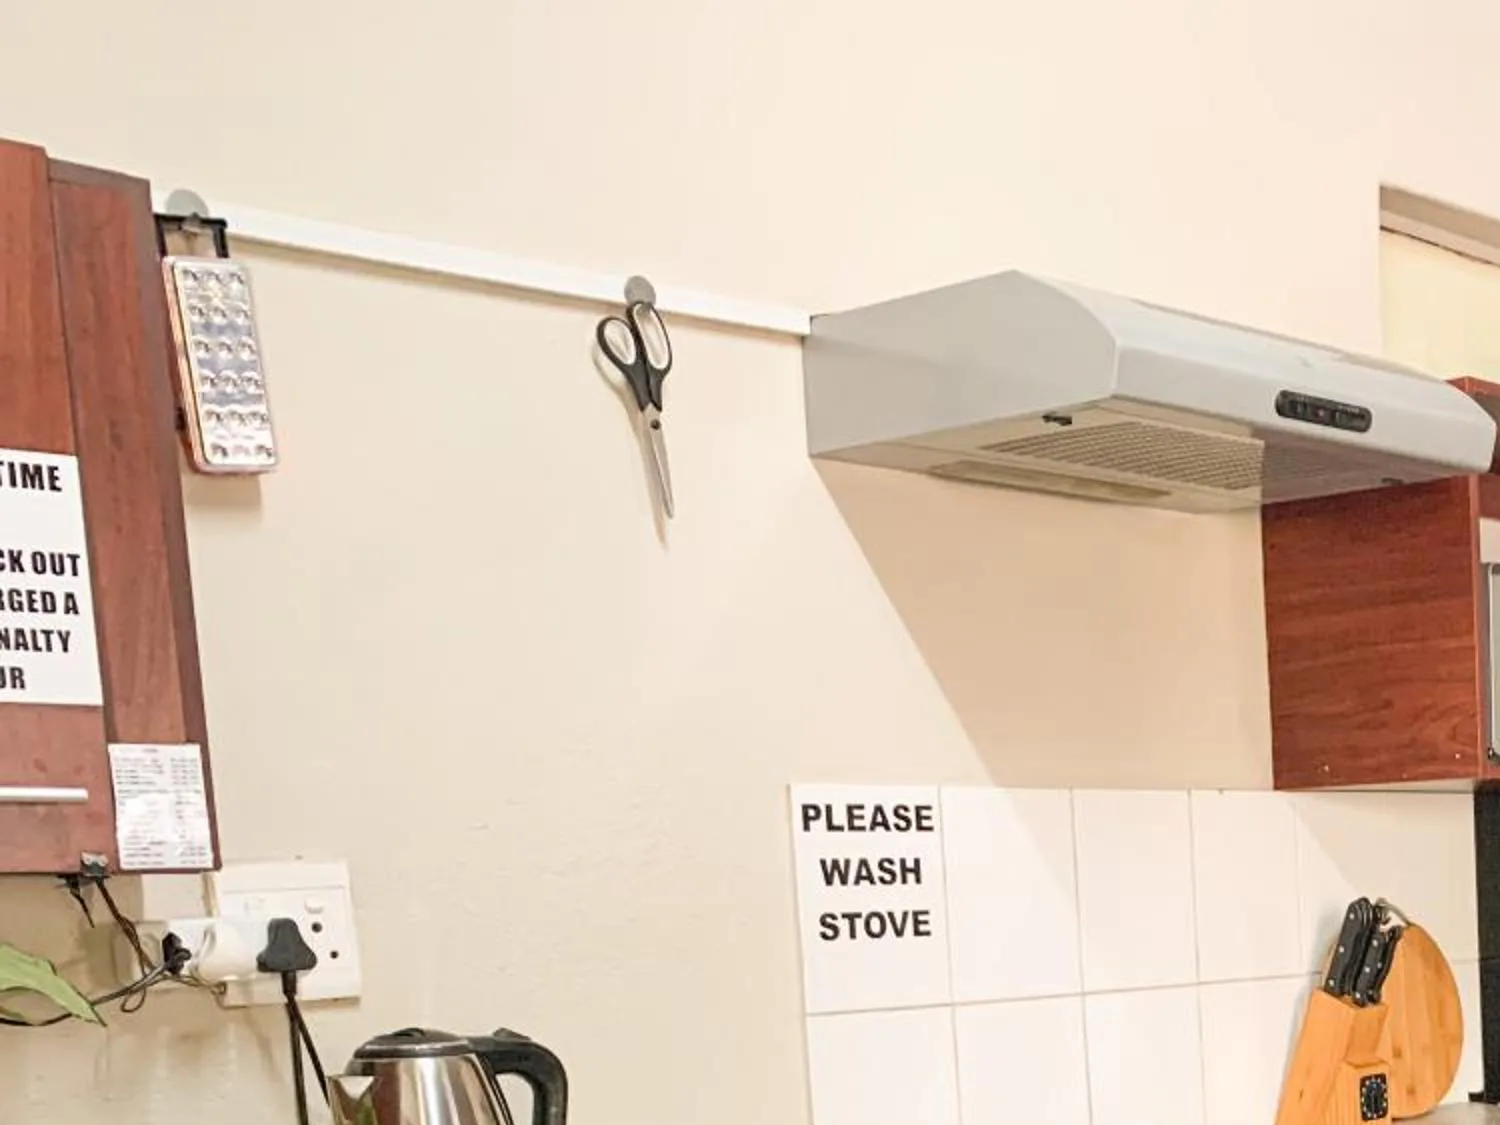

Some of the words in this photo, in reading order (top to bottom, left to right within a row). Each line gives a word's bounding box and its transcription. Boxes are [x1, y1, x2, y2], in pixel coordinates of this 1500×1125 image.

[31, 551, 80, 577] OUT
[63, 592, 80, 615] A
[801, 803, 934, 832] PLEASE
[819, 857, 922, 886] WASH
[818, 909, 932, 941] STOVE
